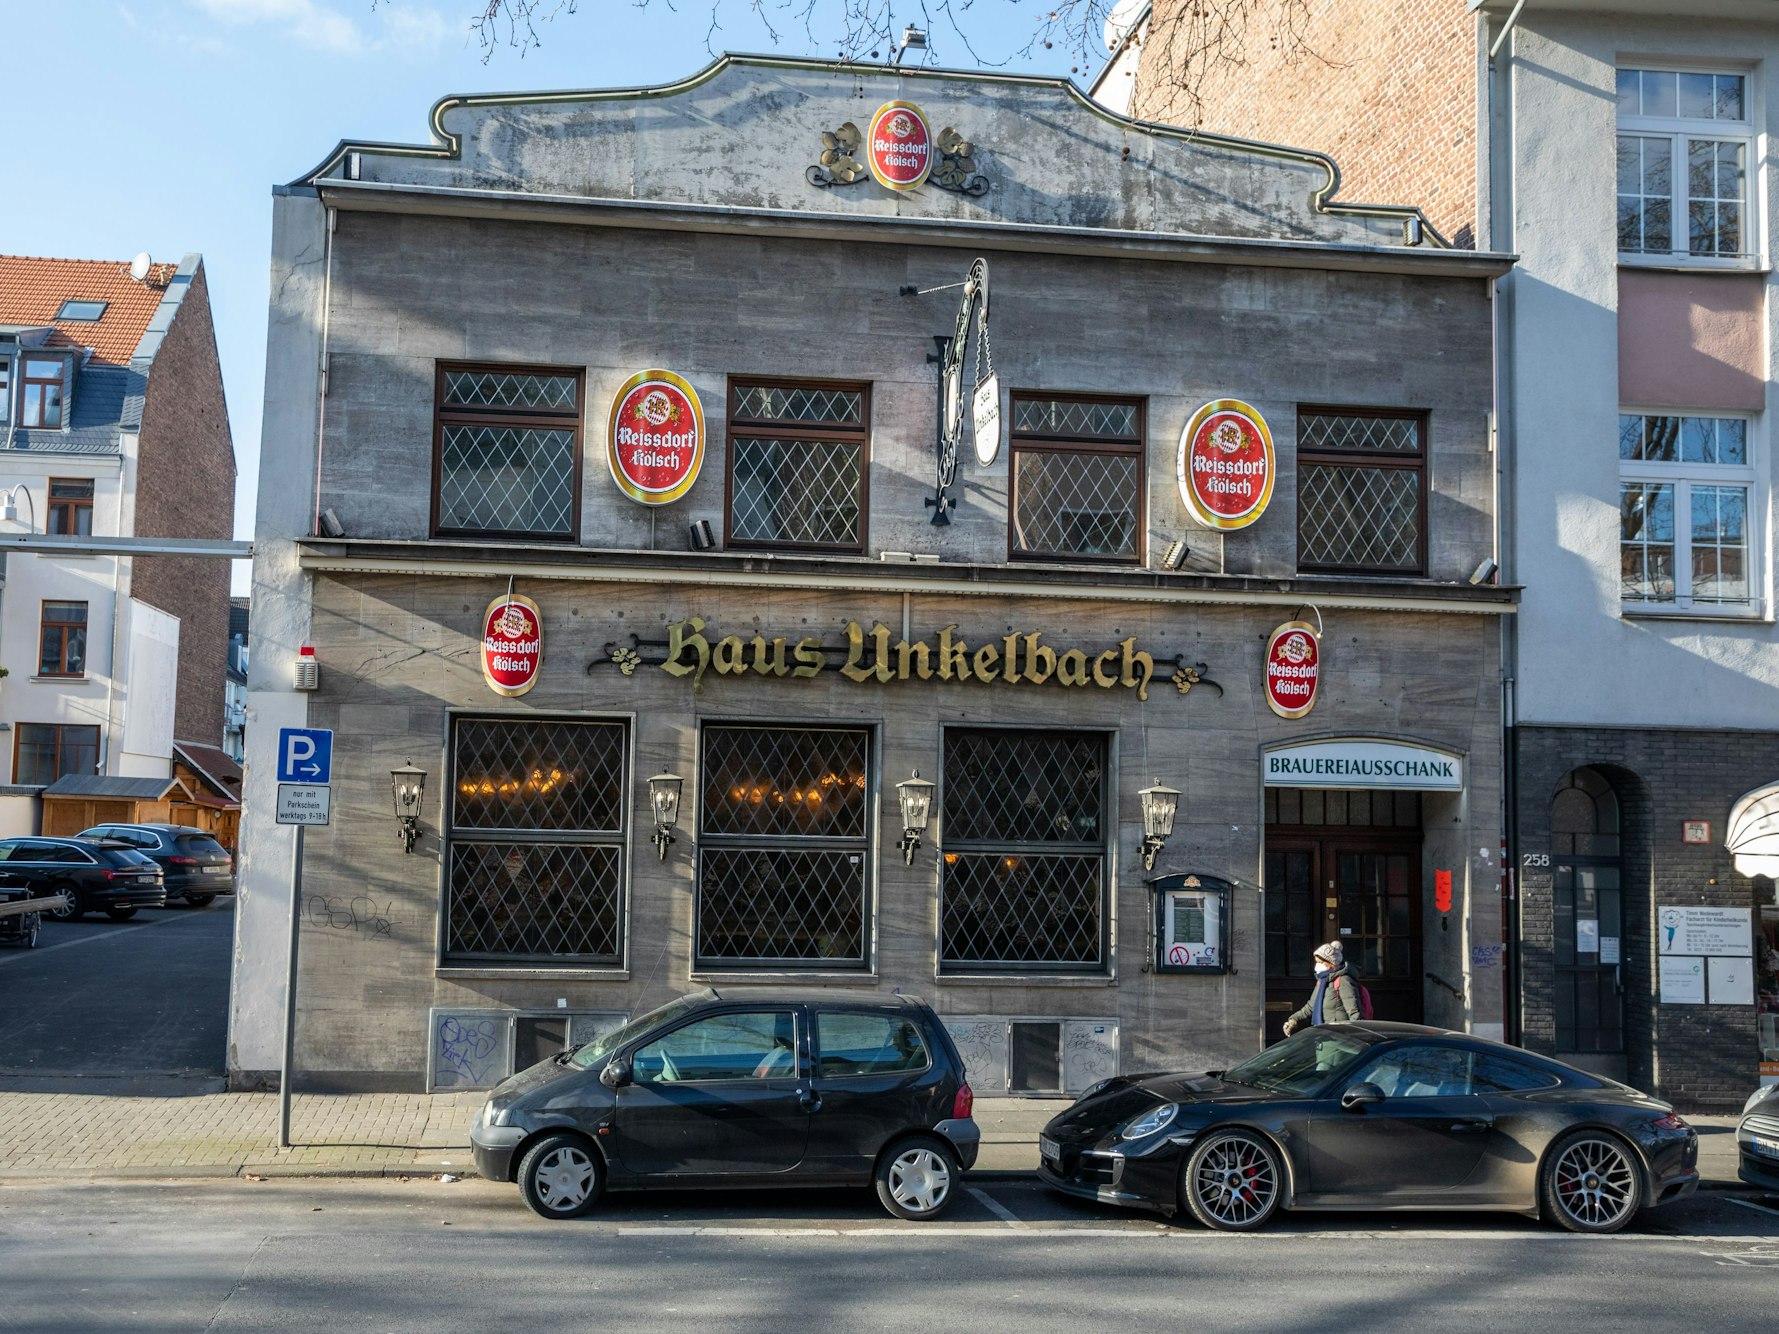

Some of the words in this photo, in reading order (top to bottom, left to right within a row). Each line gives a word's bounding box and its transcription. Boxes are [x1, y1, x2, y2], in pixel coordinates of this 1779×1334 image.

[874, 139, 928, 155] Reissdorf
[884, 154, 918, 169] Kölsch
[618, 427, 695, 448] Reissdorf
[631, 449, 680, 471] Kölsch
[1193, 455, 1265, 475] Reissdorf
[1206, 476, 1252, 497] Kölsch
[485, 636, 540, 654] Reissdorf
[492, 655, 531, 673] Kölsch
[659, 616, 828, 695] Haus
[840, 620, 1156, 701] Unkelbach
[1269, 661, 1318, 678] Reissdorf
[1275, 679, 1310, 696] Kölsch
[285, 735, 316, 775] P
[1270, 757, 1454, 778] BRAUEREIAUSSCHANK
[287, 801, 320, 809] Parkschein
[280, 812, 307, 821] werktags
[1523, 853, 1550, 867] 258
